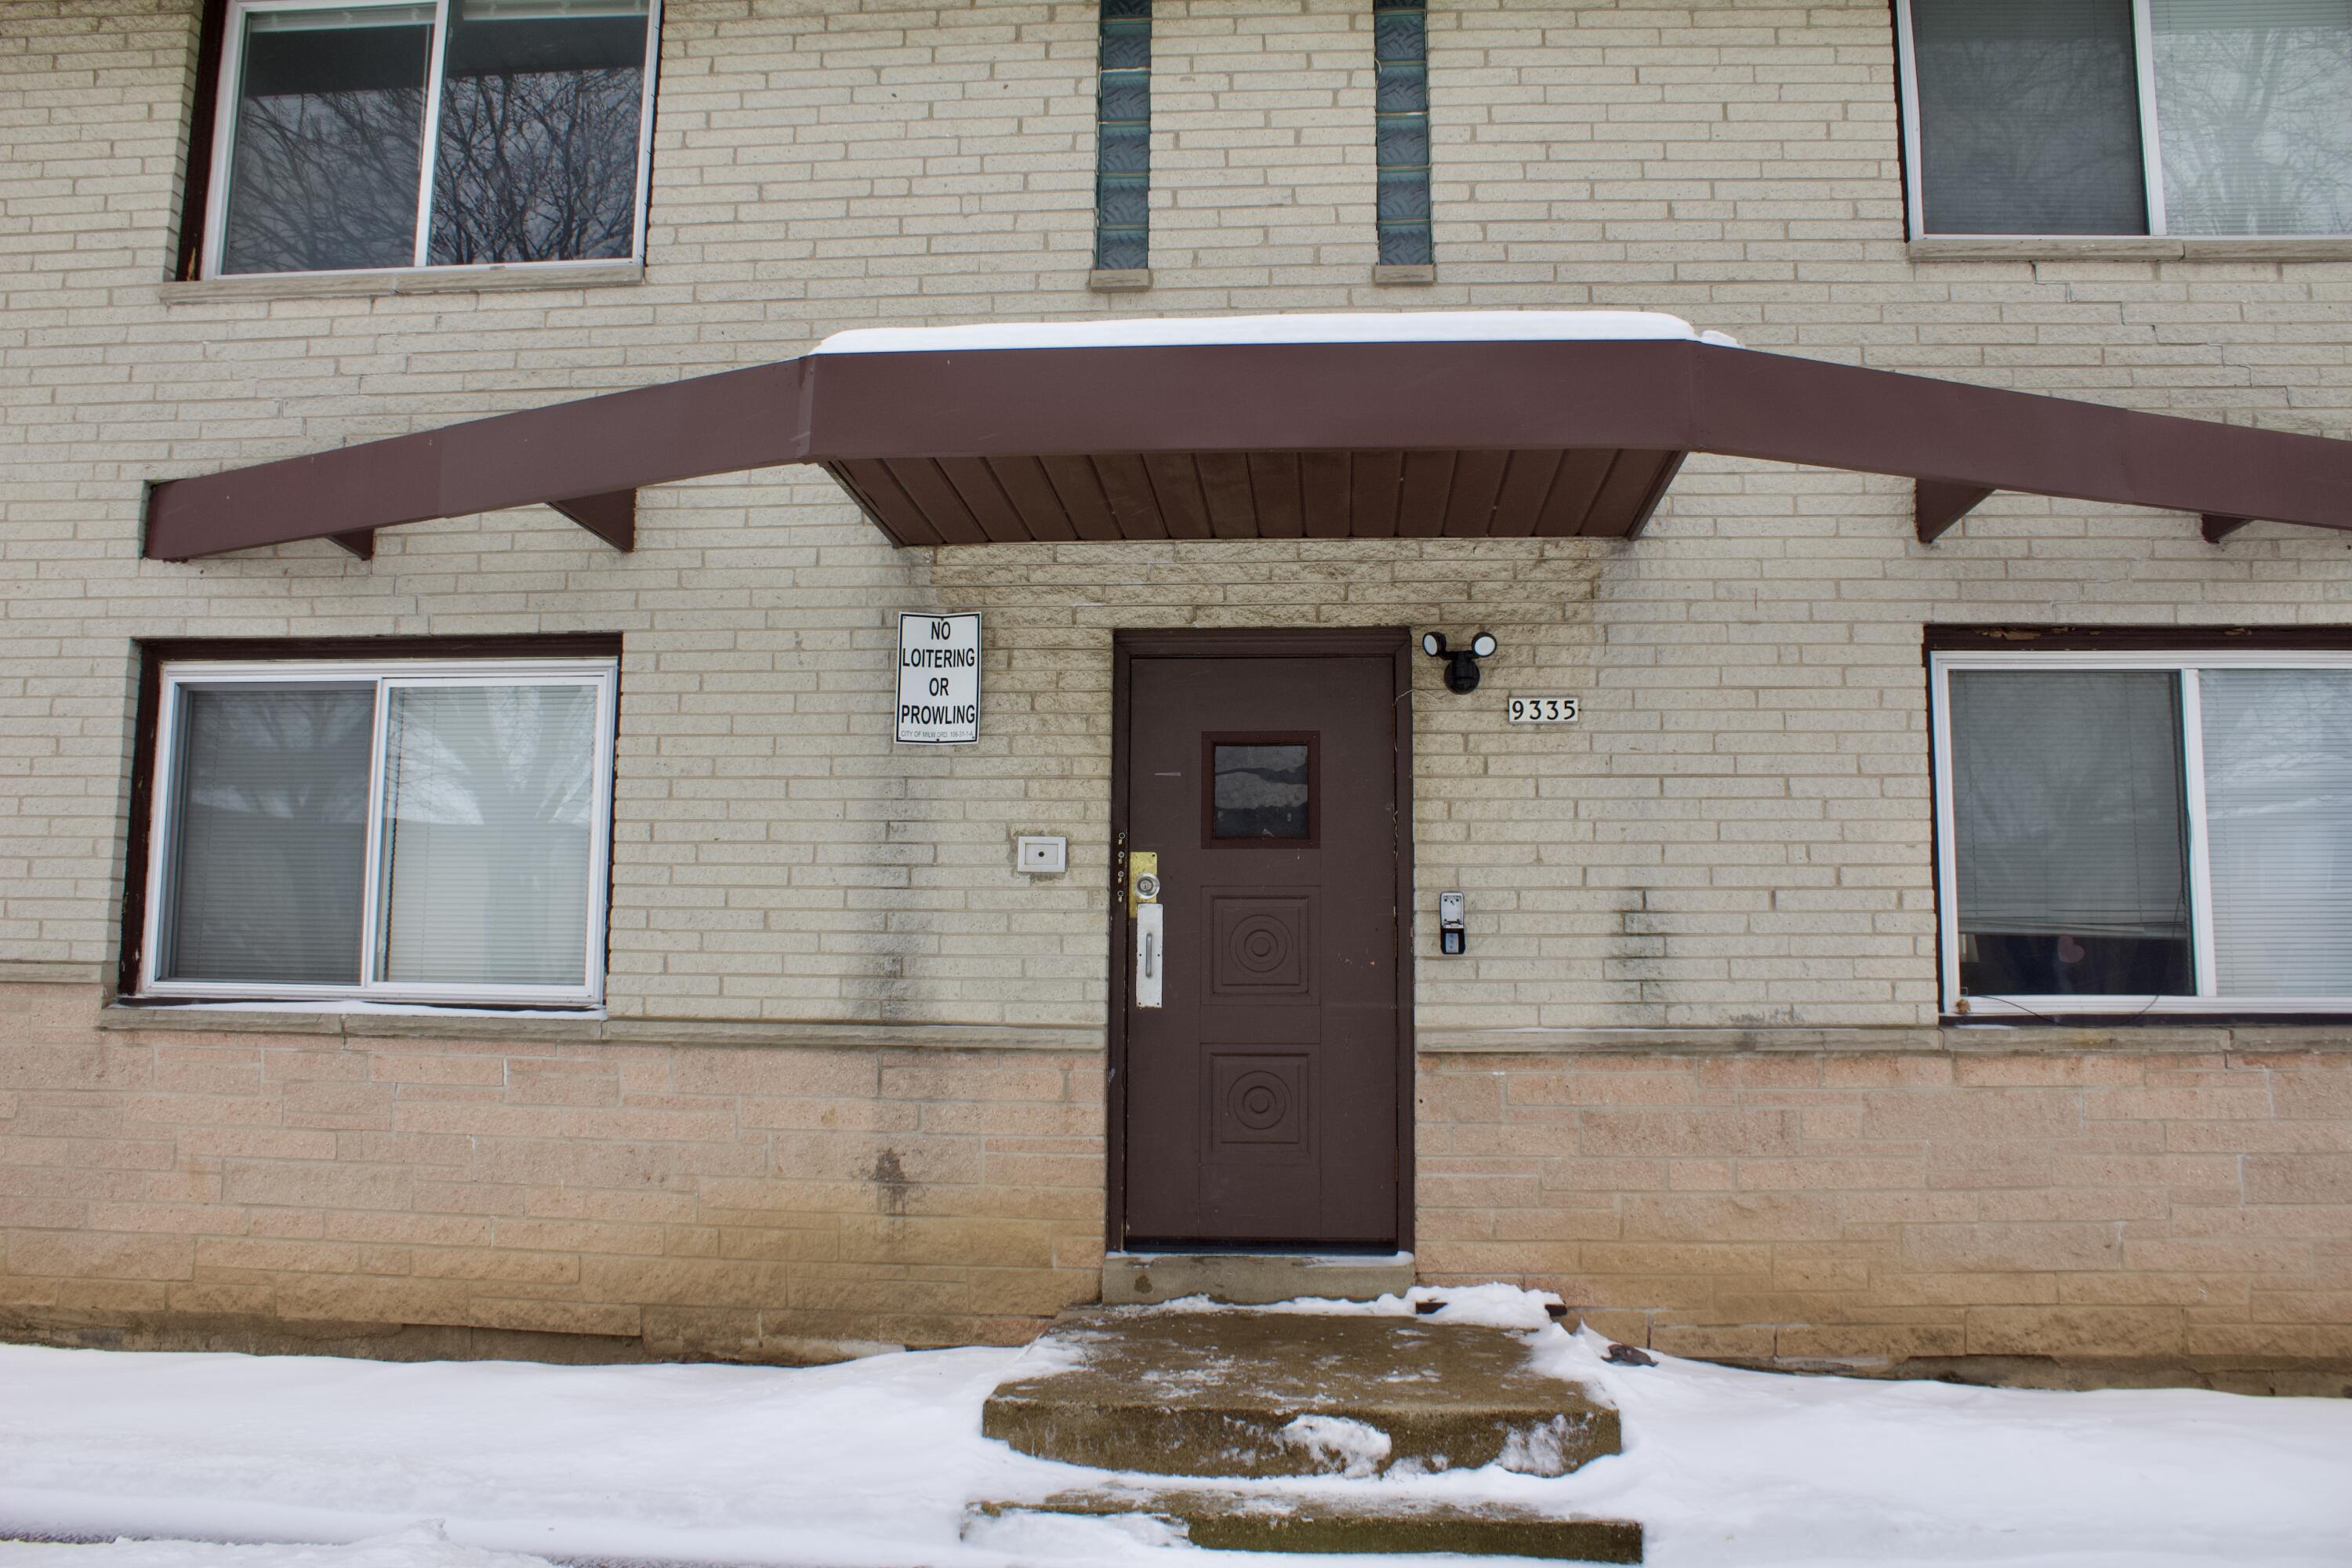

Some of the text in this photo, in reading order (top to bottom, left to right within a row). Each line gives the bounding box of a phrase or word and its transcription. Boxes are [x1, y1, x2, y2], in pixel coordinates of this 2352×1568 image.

[931, 621, 951, 640] NO
[902, 648, 975, 668] LOITERING
[929, 677, 949, 696] OR
[902, 705, 975, 724] PROWLING
[1512, 700, 1575, 720] 9335
